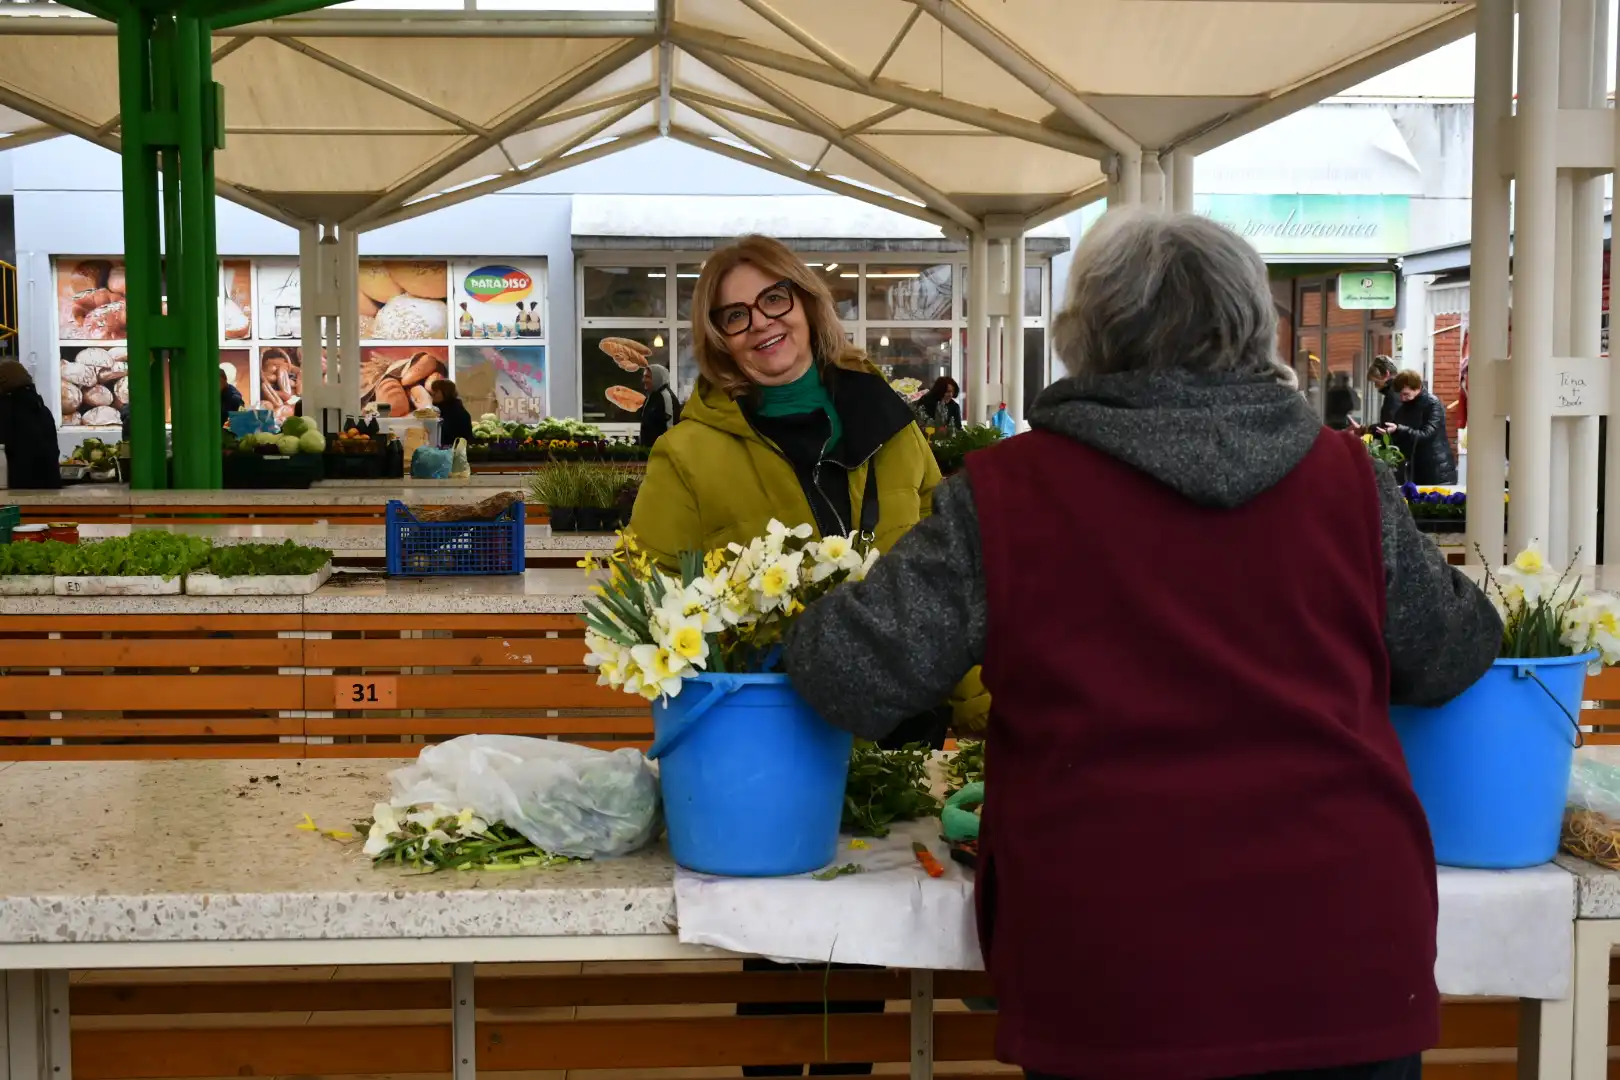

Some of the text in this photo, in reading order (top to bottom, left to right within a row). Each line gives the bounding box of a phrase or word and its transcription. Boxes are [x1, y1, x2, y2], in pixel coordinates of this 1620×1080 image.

[470, 278, 527, 289] PARADISO
[1555, 371, 1587, 387] Tina
[351, 683, 379, 702] 31
